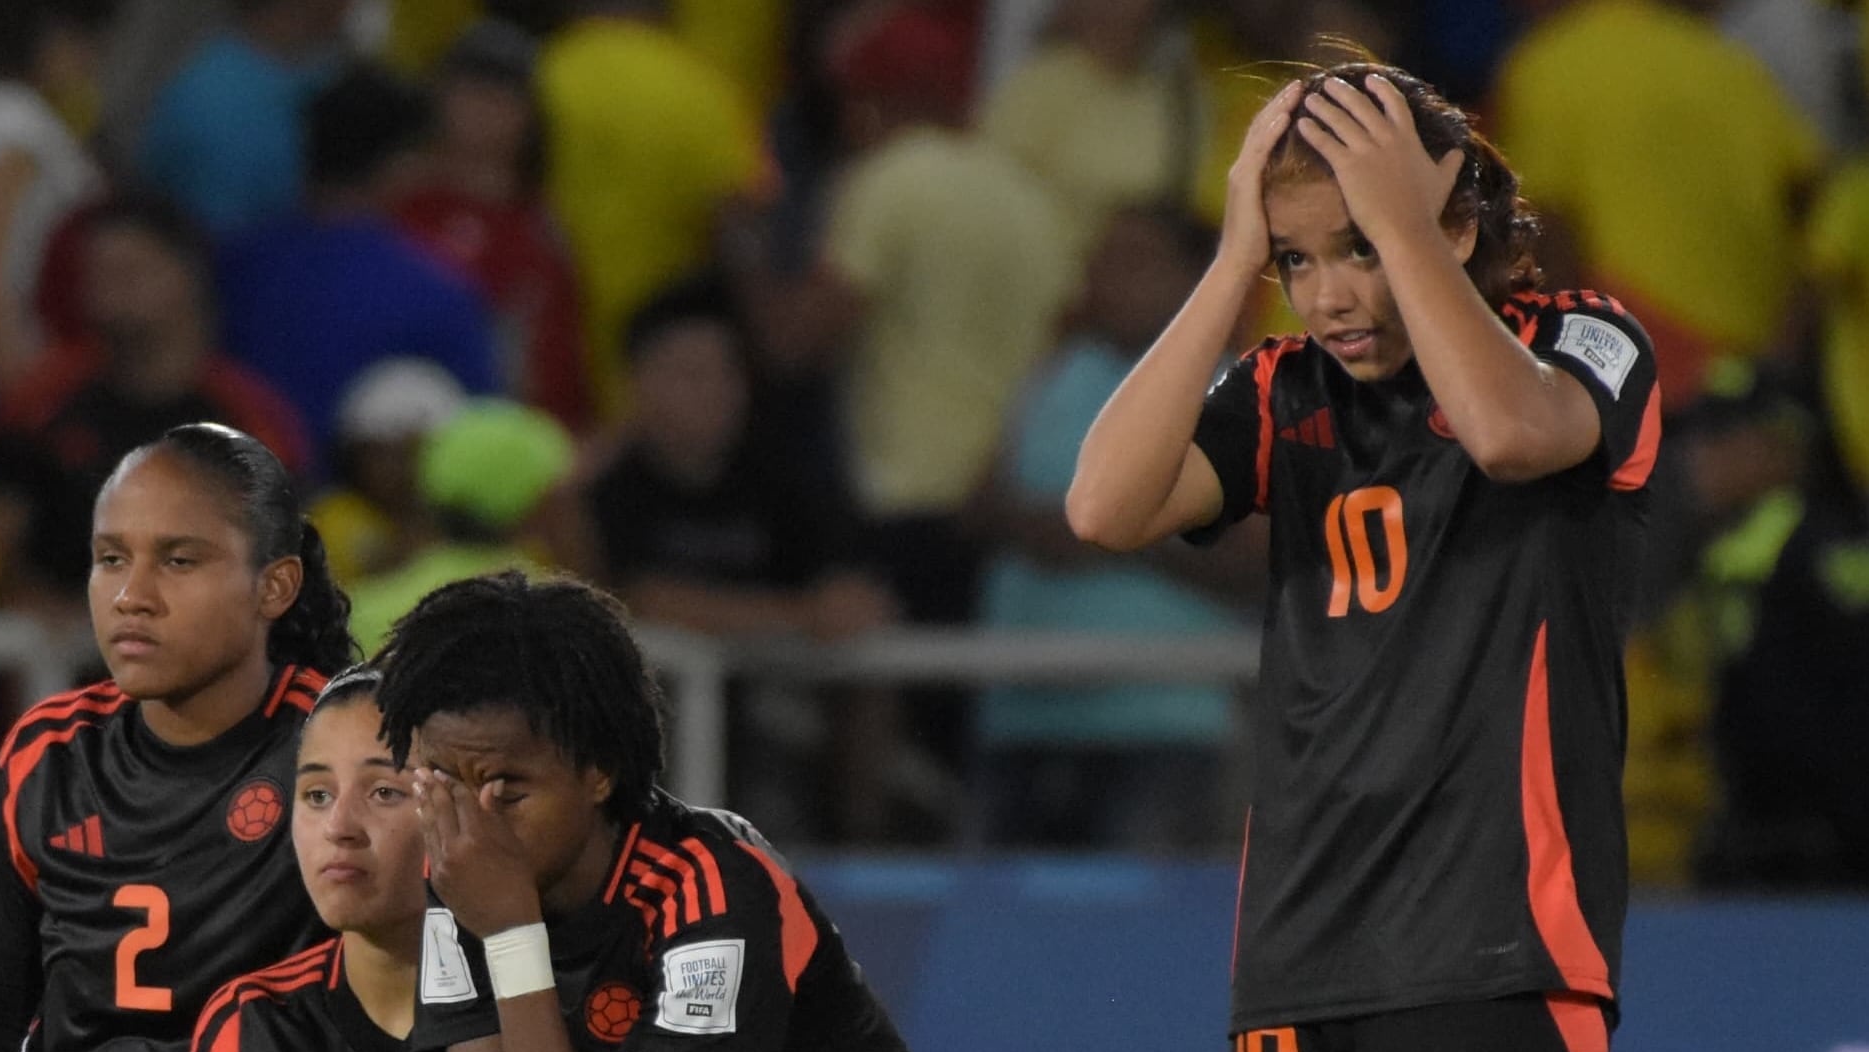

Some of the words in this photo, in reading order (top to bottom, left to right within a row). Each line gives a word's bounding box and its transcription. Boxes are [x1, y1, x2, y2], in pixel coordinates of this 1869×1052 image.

[1326, 487, 1407, 617] 10
[113, 884, 172, 1011] 2
[680, 956, 728, 975] FOOTBALL
[682, 970, 727, 988] UNITES
[694, 986, 728, 1002] World
